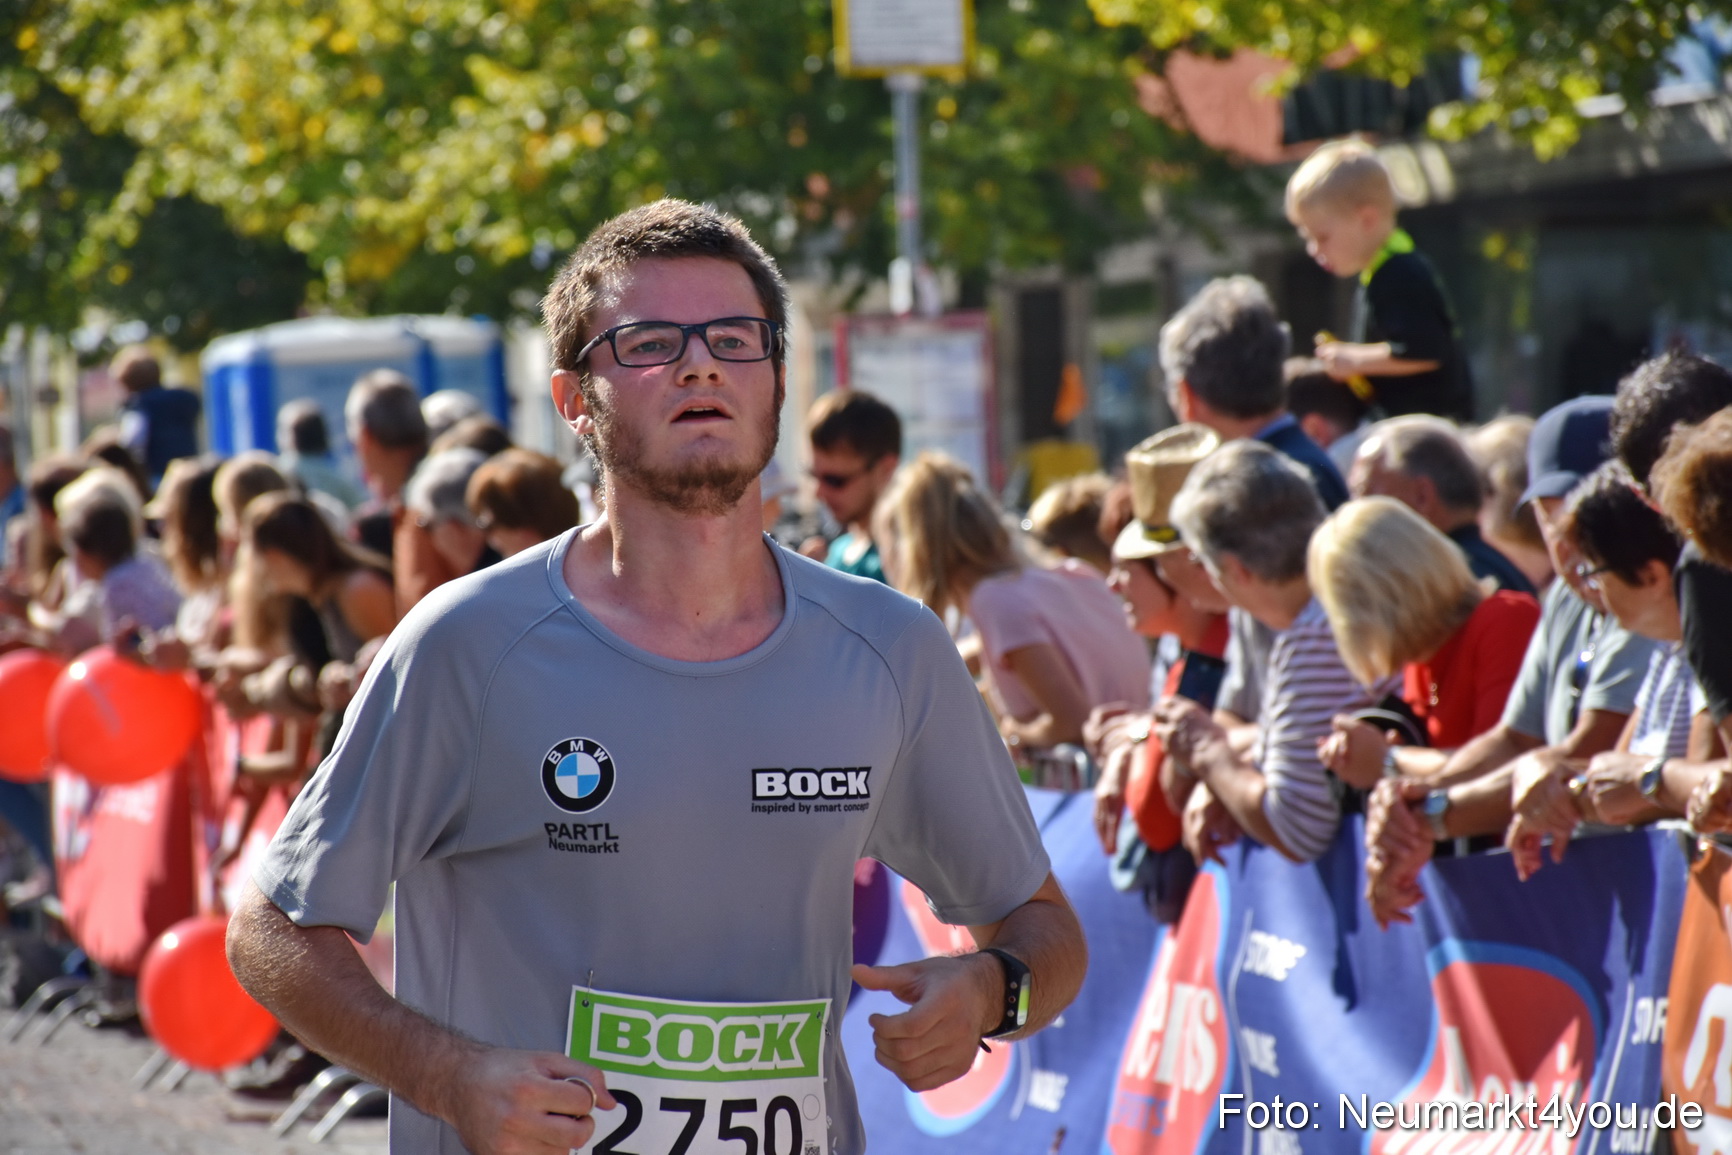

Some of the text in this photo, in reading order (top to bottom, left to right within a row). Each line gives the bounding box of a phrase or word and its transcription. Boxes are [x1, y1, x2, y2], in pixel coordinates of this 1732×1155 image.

[547, 740, 609, 765] BMW
[752, 766, 872, 801] BOCK
[751, 802, 795, 814] inspired
[798, 802, 811, 814] by
[814, 803, 842, 812] smart
[544, 822, 619, 841] PARTL
[548, 839, 619, 854] Neumarkt
[589, 1003, 811, 1072] BOCK
[592, 1089, 803, 1155] 2750
